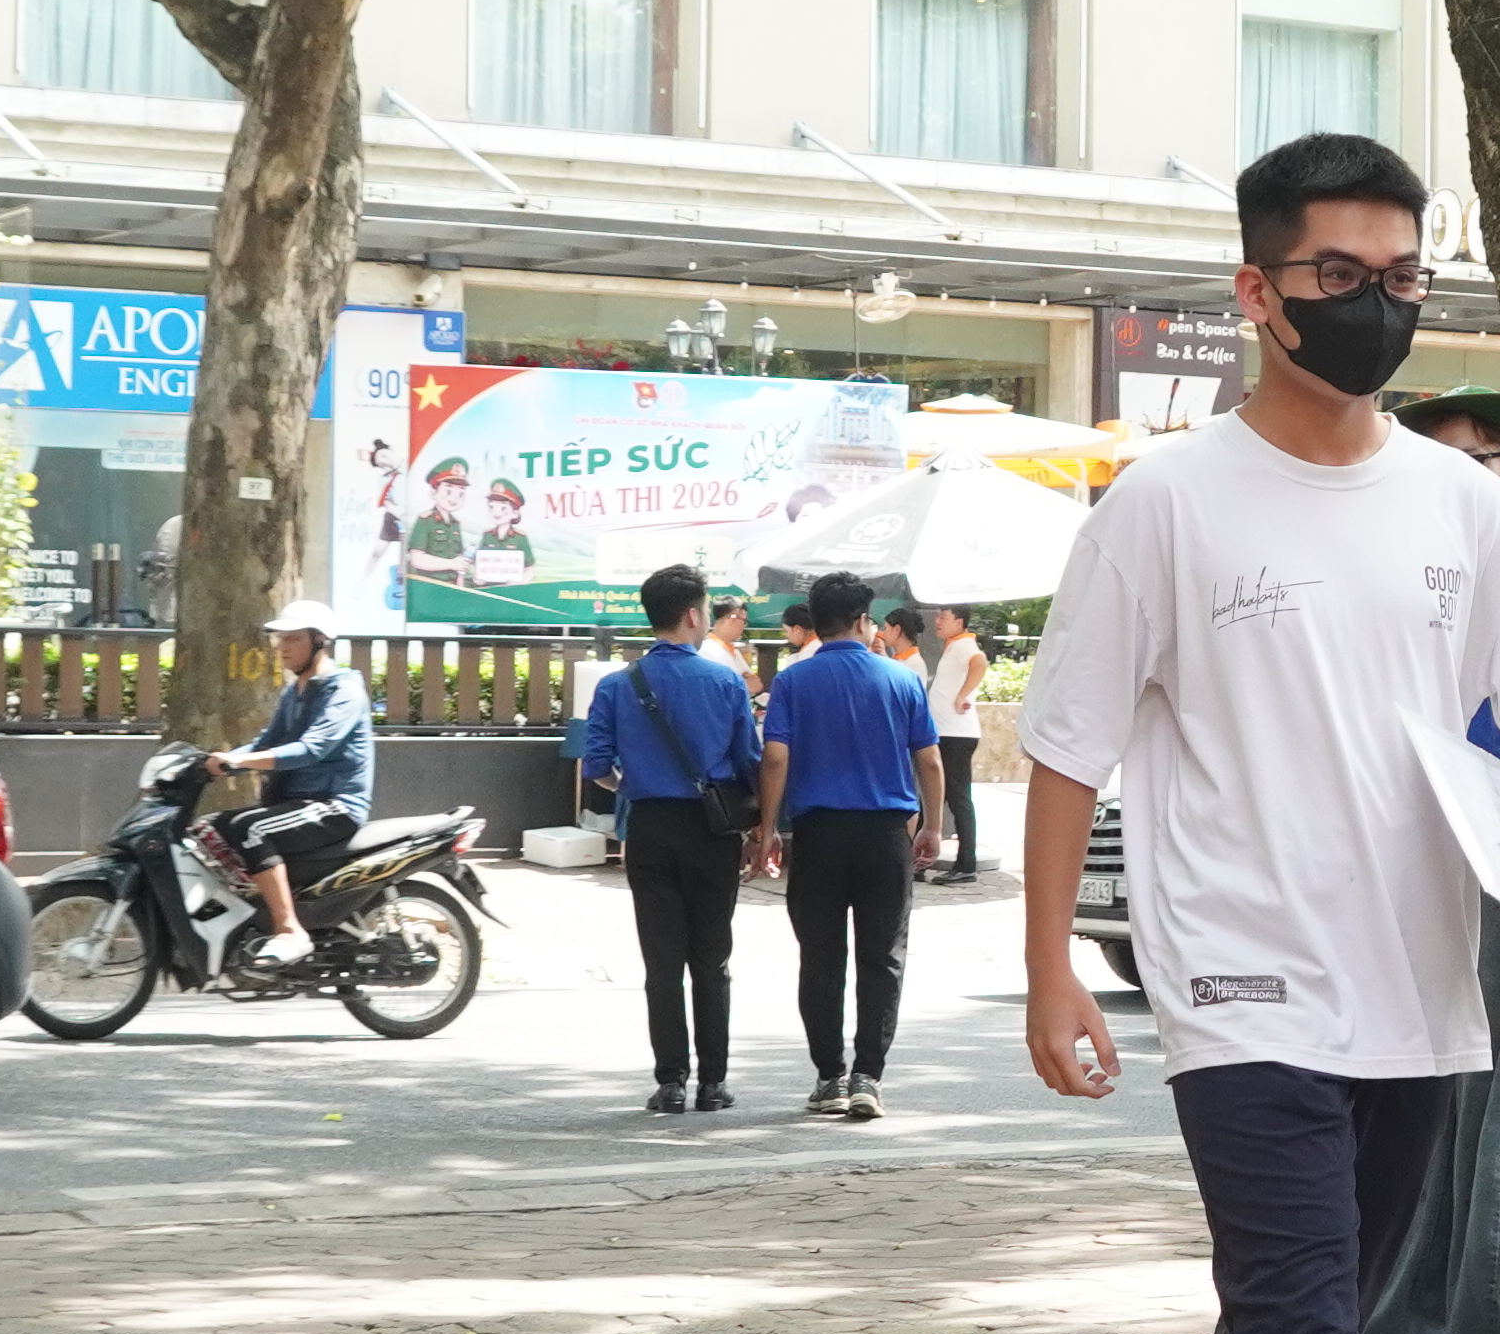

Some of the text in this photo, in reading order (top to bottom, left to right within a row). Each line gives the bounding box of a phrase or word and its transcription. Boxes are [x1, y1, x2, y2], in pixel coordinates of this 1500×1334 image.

[1157, 318, 1237, 338] Open Space
[1182, 344, 1194, 360] &
[518, 434, 710, 478] TIẾP SỨC
[544, 479, 739, 519] MÙA THI 2026
[1424, 565, 1462, 595] GOOD
[1439, 594, 1458, 622] BOY
[1220, 979, 1279, 989] degenerate
[1236, 990, 1280, 1000] REBORN
